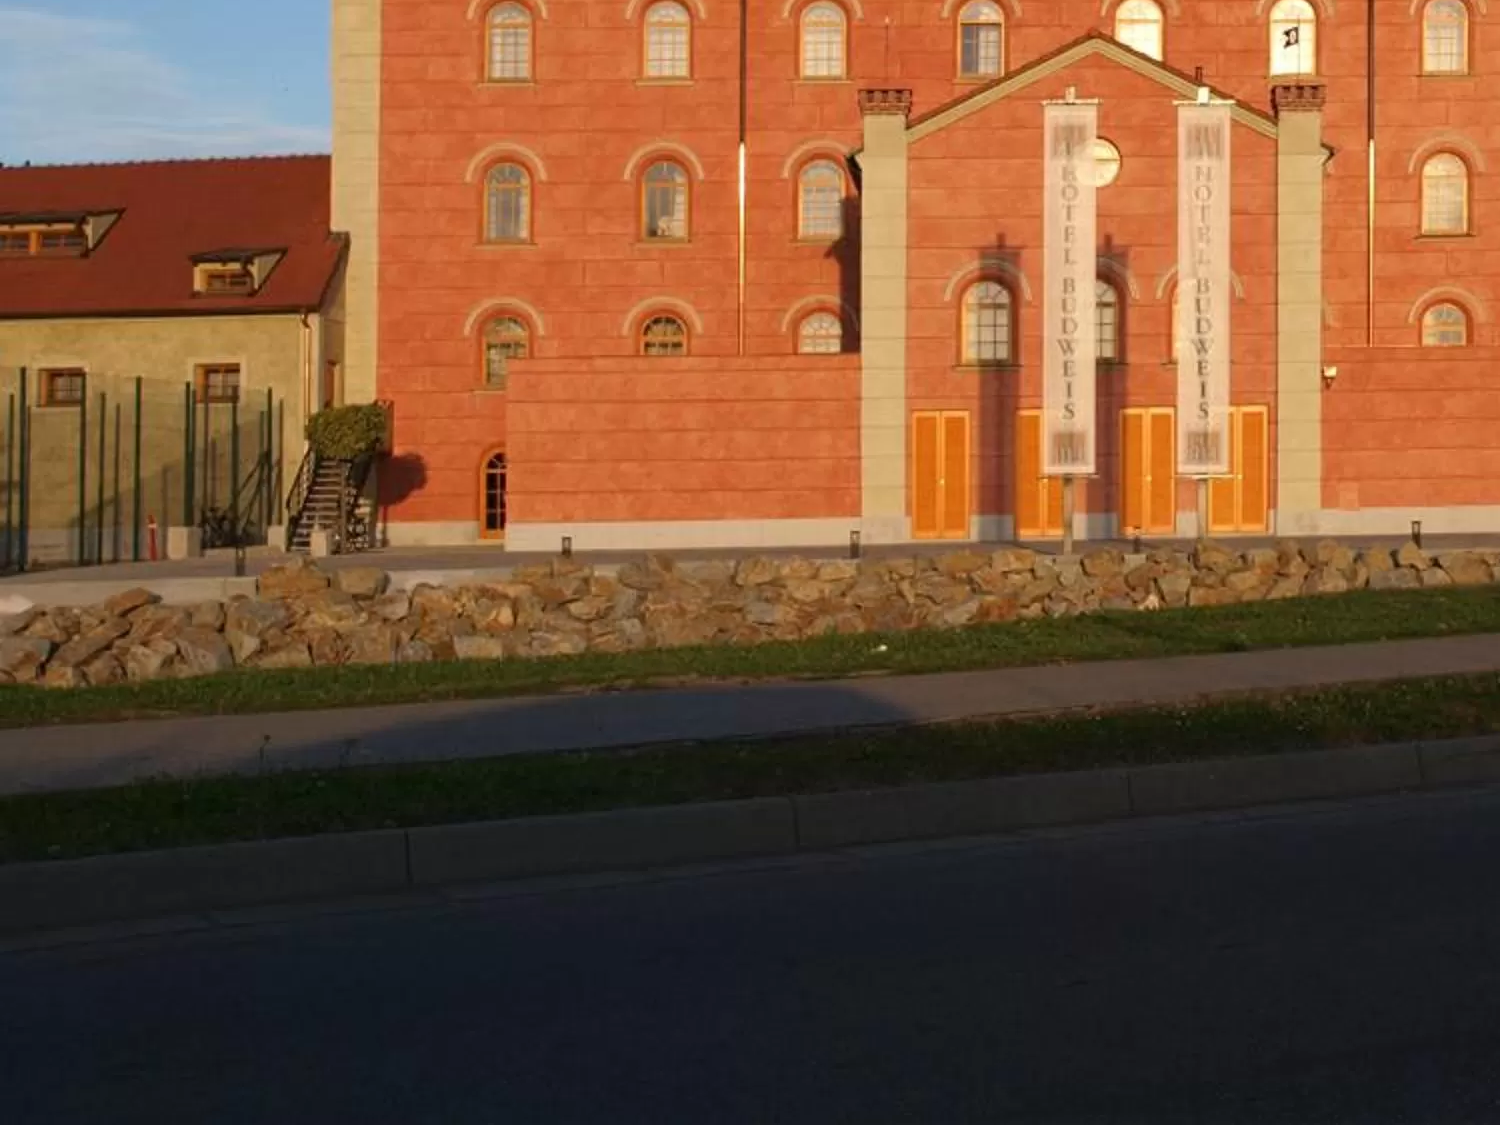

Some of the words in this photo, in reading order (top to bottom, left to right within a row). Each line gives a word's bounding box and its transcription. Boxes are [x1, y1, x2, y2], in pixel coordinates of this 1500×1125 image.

[1061, 166, 1079, 265] HOTEL
[1194, 166, 1212, 265] HOTEL
[1057, 278, 1081, 420] BUDWEIS
[1191, 278, 1214, 420] BUDWEIS
